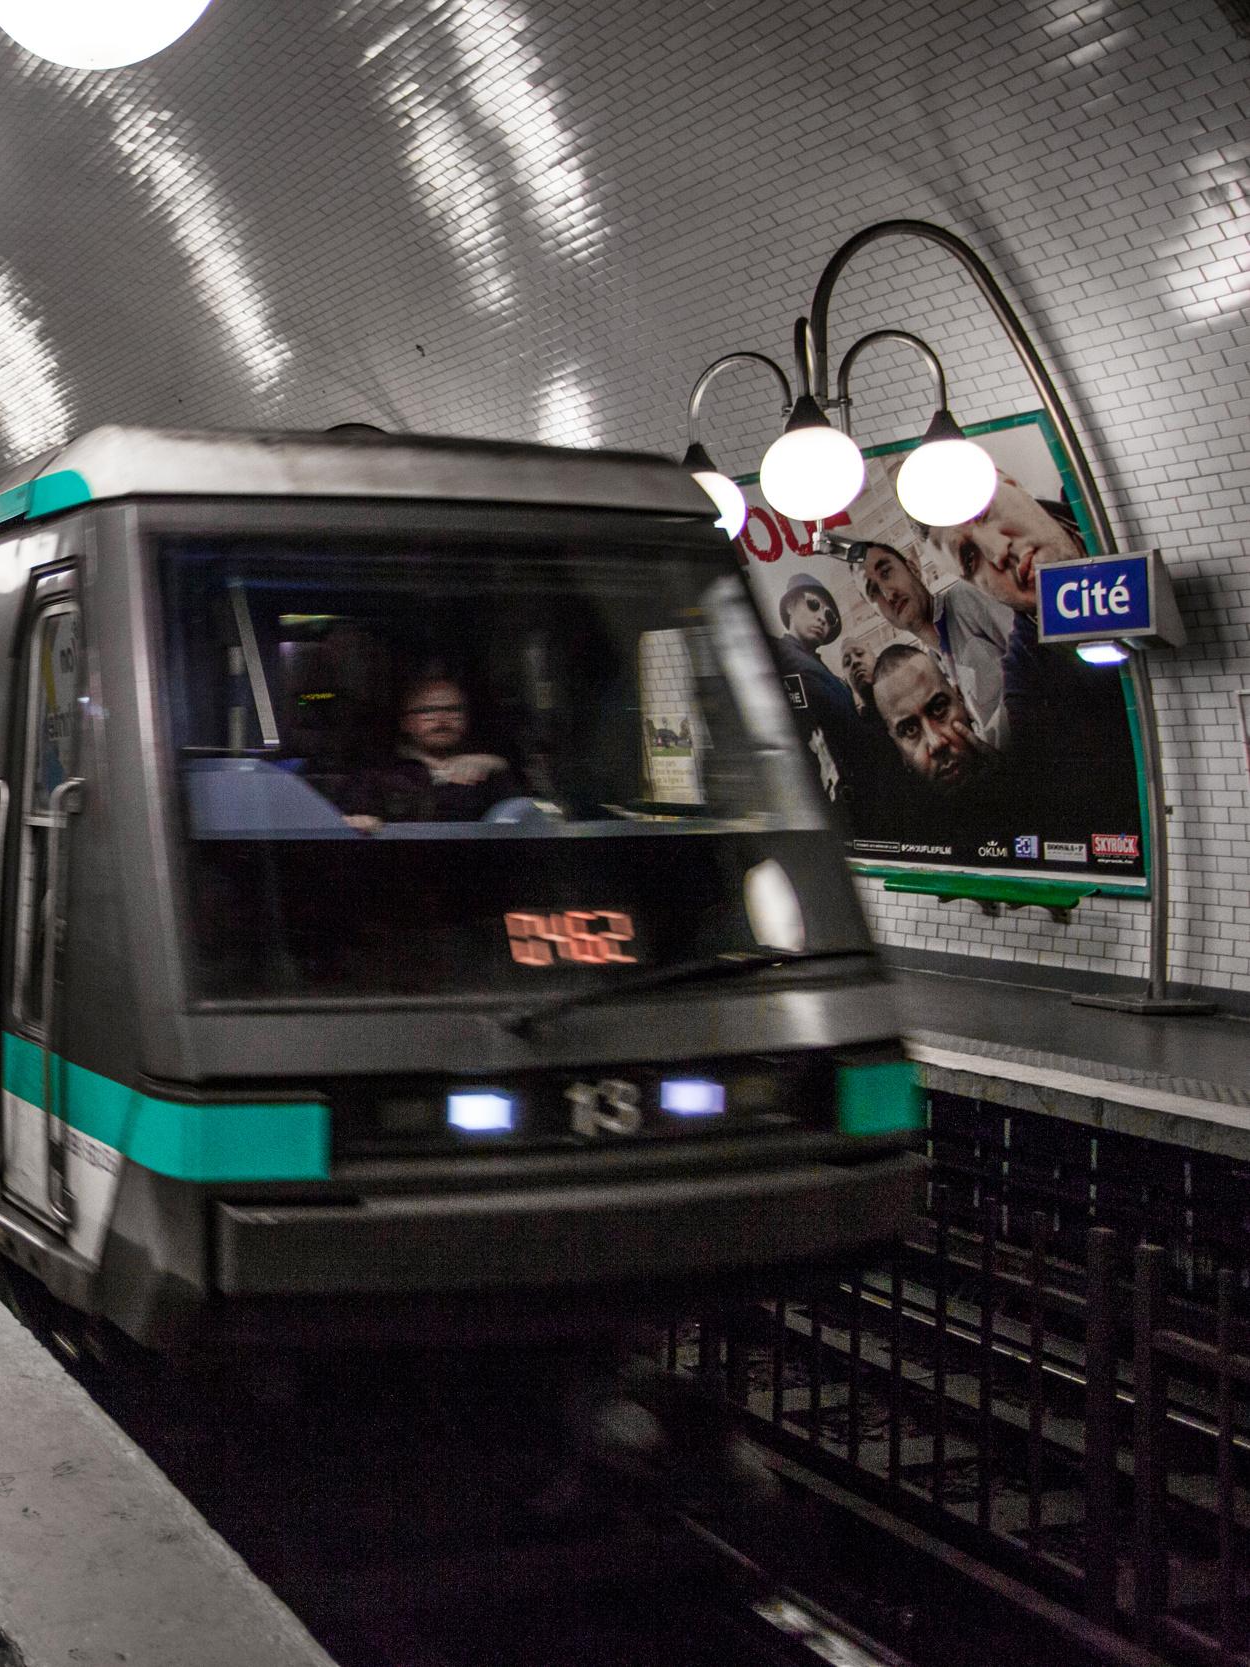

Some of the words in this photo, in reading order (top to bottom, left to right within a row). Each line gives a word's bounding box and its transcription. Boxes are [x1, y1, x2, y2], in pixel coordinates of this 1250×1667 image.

[1056, 574, 1130, 619] Cité
[977, 846, 1008, 857] OKLM
[1014, 836, 1031, 853] 20
[1094, 837, 1135, 853] SKYROCK
